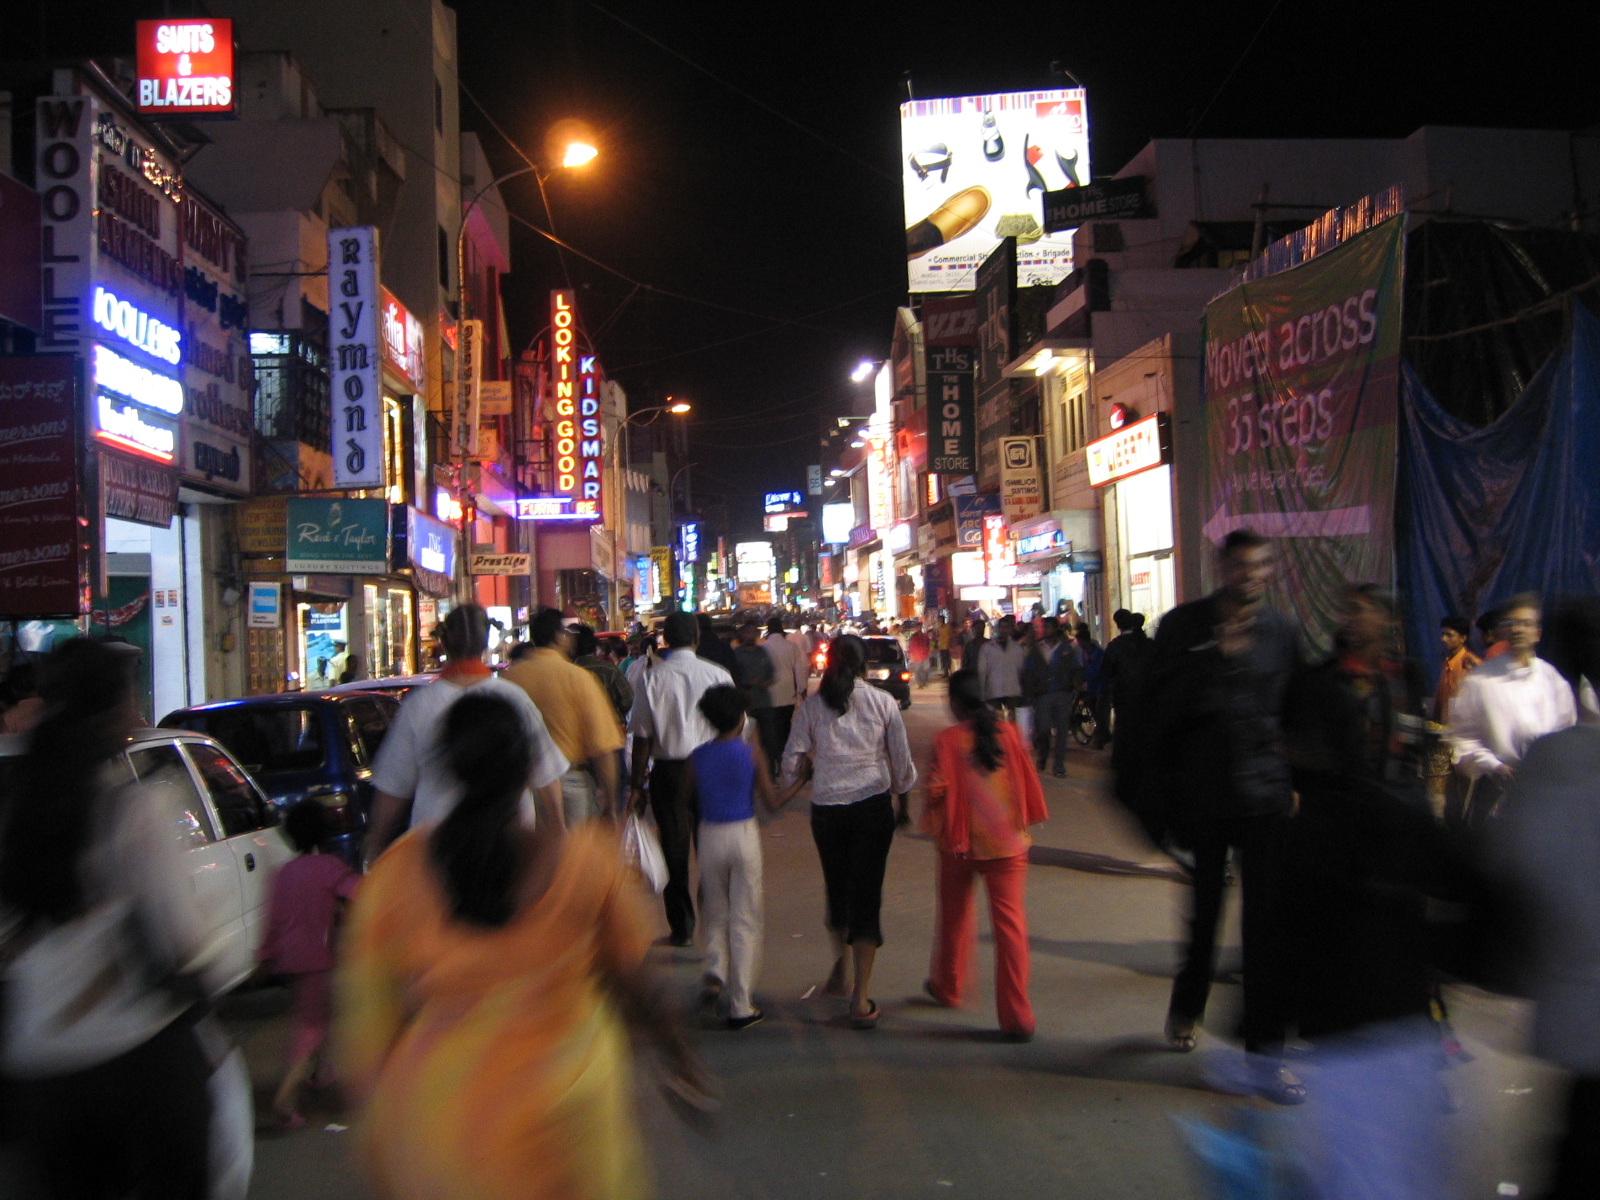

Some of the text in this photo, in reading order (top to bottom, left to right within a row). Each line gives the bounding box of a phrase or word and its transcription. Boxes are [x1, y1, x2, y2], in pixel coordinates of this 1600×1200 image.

[156, 24, 215, 53] SUITS
[178, 54, 192, 77] &
[139, 77, 232, 107] BLAZERS
[1053, 199, 1108, 221] HOME
[933, 254, 976, 264] Commercial
[1042, 249, 1070, 260] Brigade
[1205, 288, 1378, 390] Moved across
[338, 238, 370, 474] Raymond
[931, 347, 970, 370] THS
[942, 385, 960, 455] HOME
[1227, 392, 1254, 456] 35
[934, 457, 970, 470] STORE
[341, 524, 378, 551] Taylor
